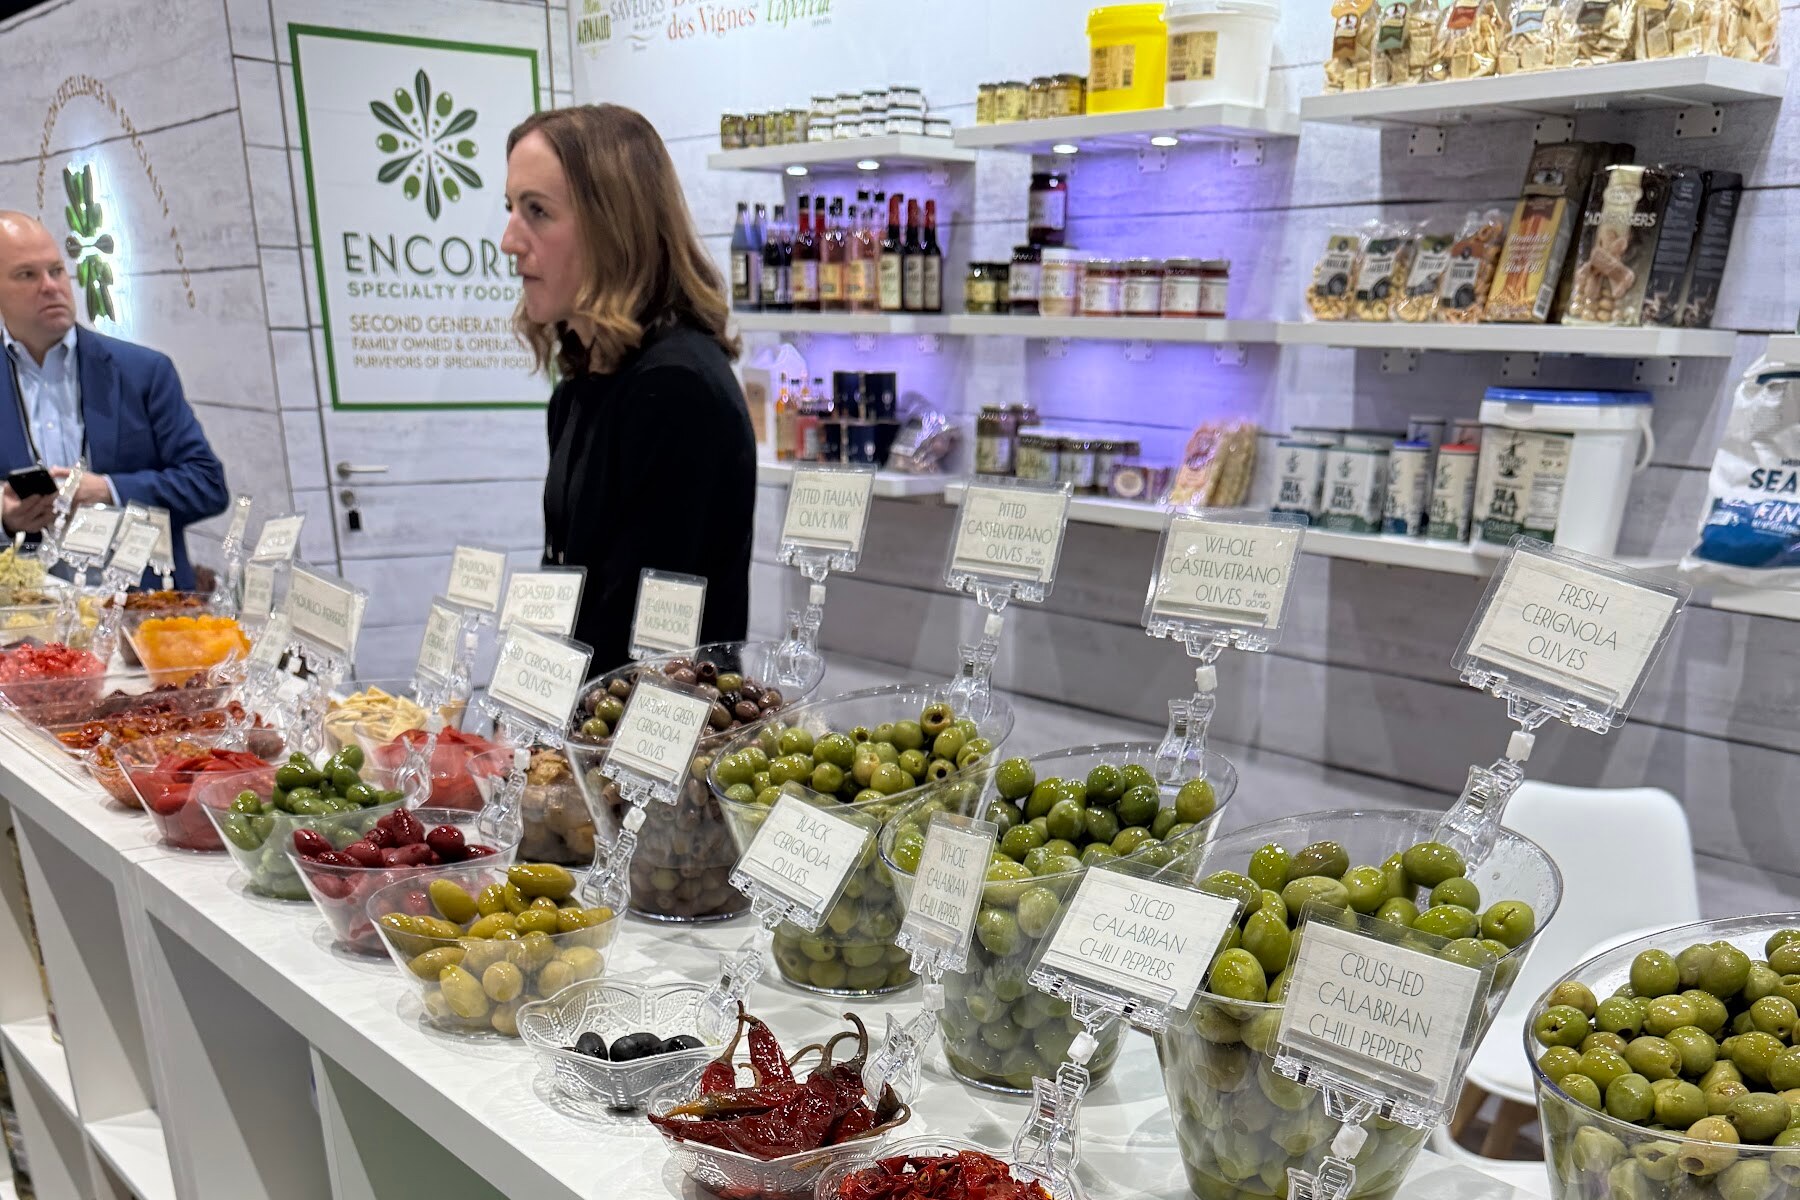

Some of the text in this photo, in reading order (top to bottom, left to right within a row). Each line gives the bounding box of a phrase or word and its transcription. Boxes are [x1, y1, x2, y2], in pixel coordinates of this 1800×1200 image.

[668, 13, 696, 40] des
[347, 280, 456, 299] SPECIALTY
[350, 314, 423, 332] SECOND
[352, 335, 398, 351] FAMILY
[1749, 468, 1798, 494] SEA
[822, 488, 863, 509] ITALIAN
[998, 501, 1027, 519] PITTED
[799, 510, 850, 531] OLIVE MIX
[966, 519, 1053, 545] CASTELVETRANO
[986, 543, 1023, 563] OLIVES
[1205, 535, 1257, 558] WHOLE
[1170, 557, 1281, 586] CASTELVETRANO
[511, 583, 556, 600] ROASTED
[1195, 583, 1242, 607] OLIVES
[1558, 583, 1610, 615] FRESH
[1521, 603, 1617, 651] CERIGNOLA
[1527, 635, 1588, 671] OLIVES
[525, 652, 572, 683] CERIGNOLA
[518, 670, 553, 698] OLIVES
[637, 695, 699, 727] NATURAL GREEN
[636, 716, 681, 744] CERIGNOLA
[637, 739, 666, 761] OLIVES
[796, 815, 832, 843] BLACK
[773, 830, 831, 871] CERIGNOLA
[940, 842, 969, 870] WHOLE
[771, 857, 810, 886] OLIVES
[926, 867, 969, 899] CALABRIAN
[936, 899, 962, 927] PEPPERS
[1124, 893, 1175, 921] SLICED
[1092, 913, 1188, 955] CALABRIAN
[1078, 937, 1176, 981] CHILI PEPPERS
[1340, 952, 1425, 997] CRUSHED
[1318, 981, 1433, 1039] CALABRIAN
[1308, 1013, 1424, 1073] CHILI PEPPERS
